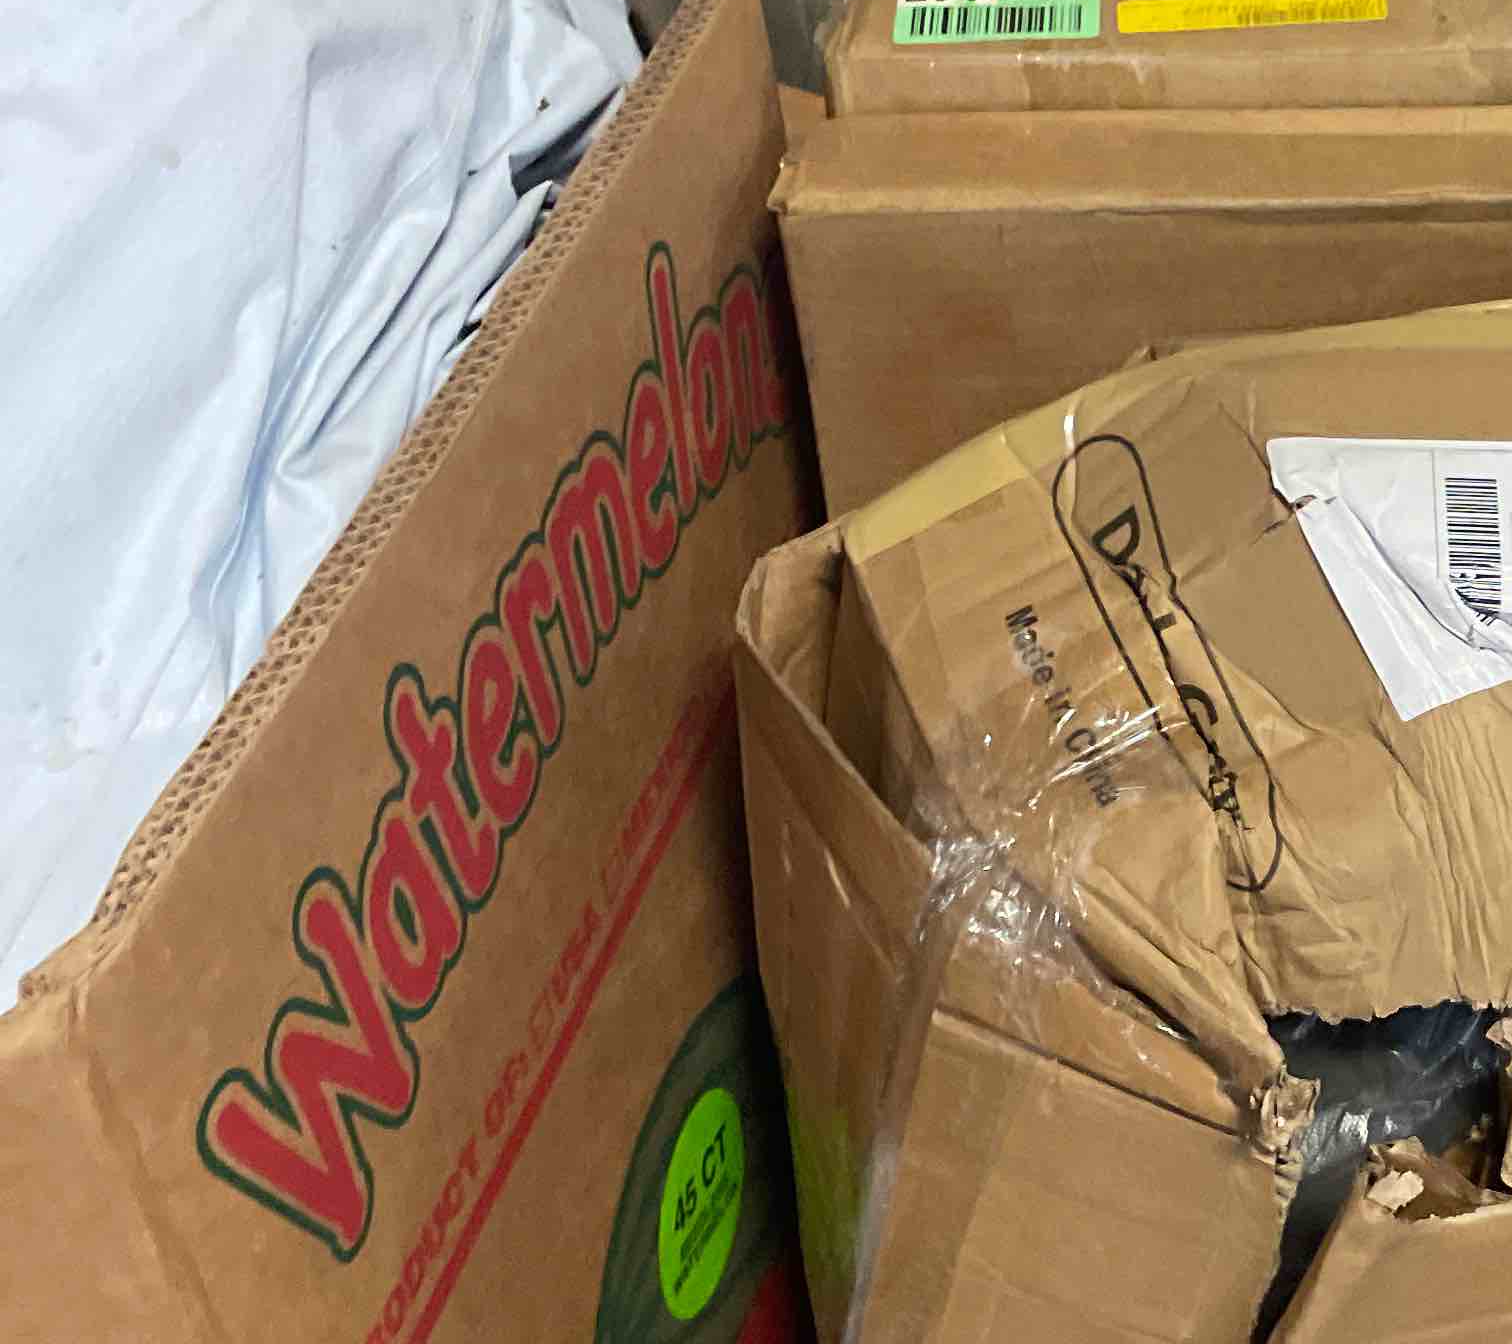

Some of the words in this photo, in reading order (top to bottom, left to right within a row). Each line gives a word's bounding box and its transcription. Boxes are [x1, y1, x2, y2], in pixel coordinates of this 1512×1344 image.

[1005, 603, 1056, 687] Made
[1043, 685, 1075, 725] in
[673, 1175, 698, 1233] 45
[700, 1120, 727, 1188] CT
